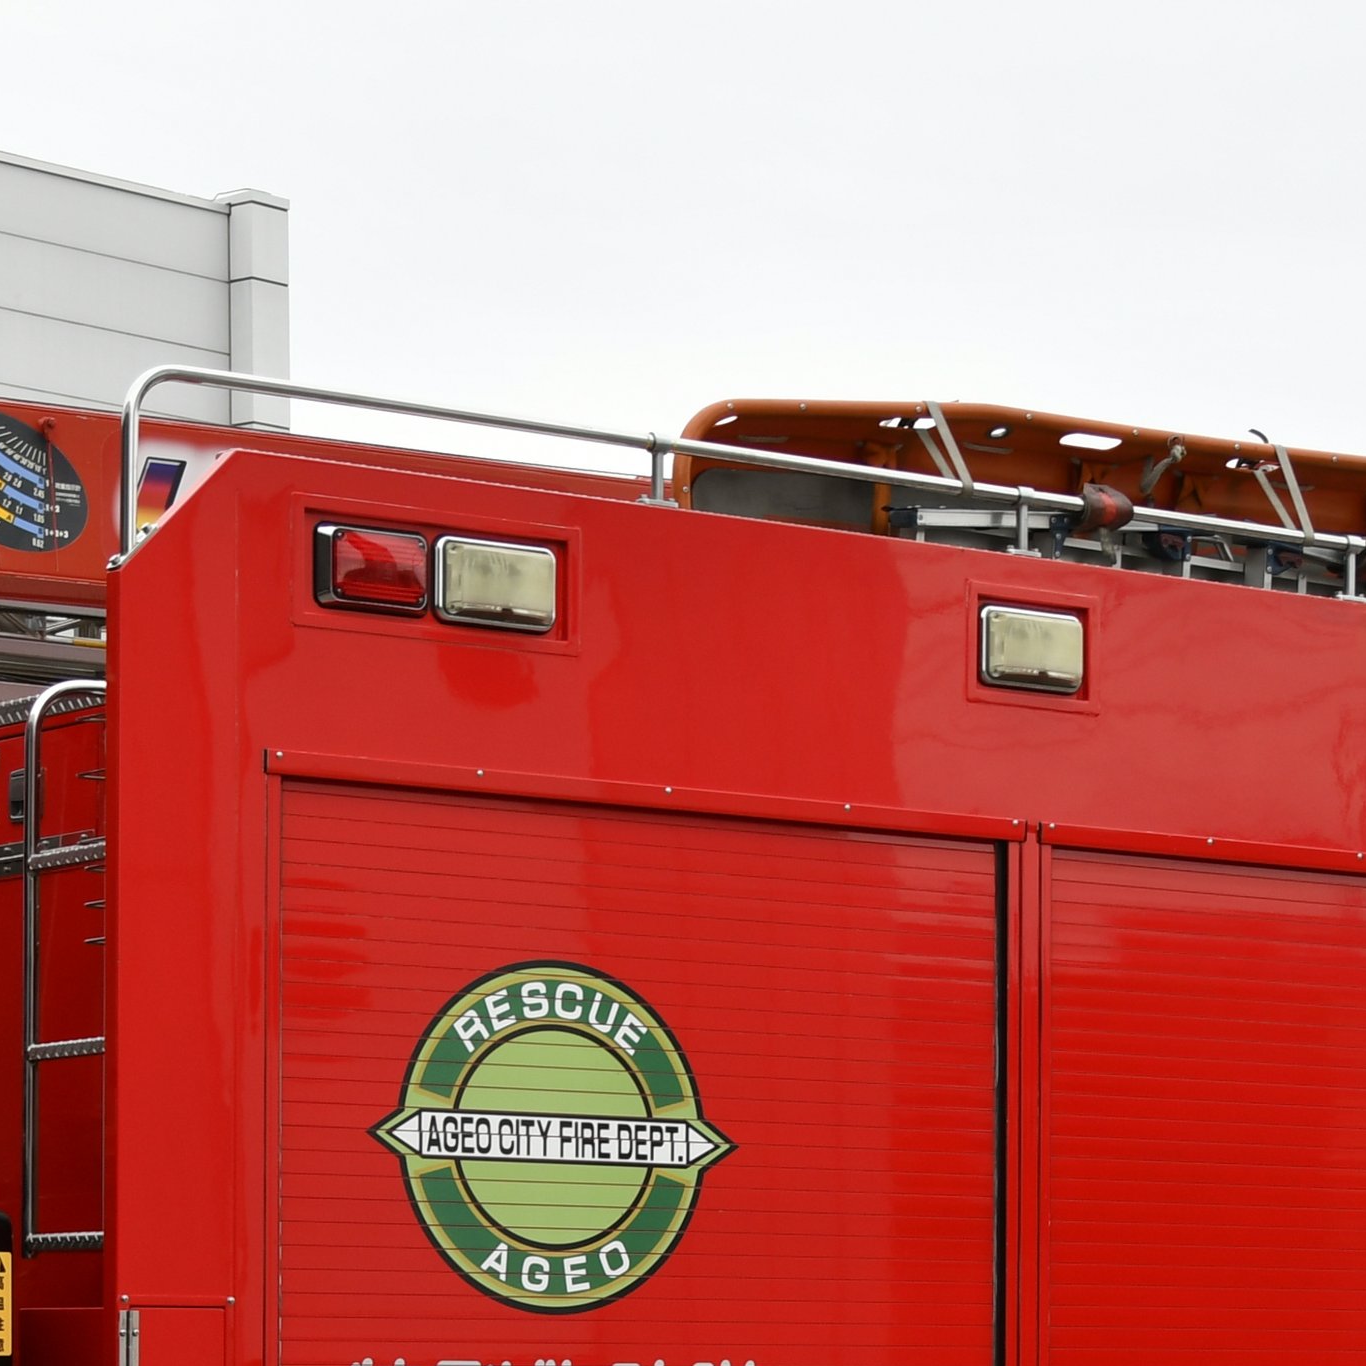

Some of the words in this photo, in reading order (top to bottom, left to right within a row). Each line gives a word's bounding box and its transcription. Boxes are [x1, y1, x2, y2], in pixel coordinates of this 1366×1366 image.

[453, 981, 649, 1056] RESCUE
[427, 1115, 491, 1154] AGEO
[499, 1117, 551, 1157] CITY
[559, 1120, 611, 1160] FIRE
[617, 1123, 684, 1162] DEPT.
[481, 1239, 633, 1294] AGEO
